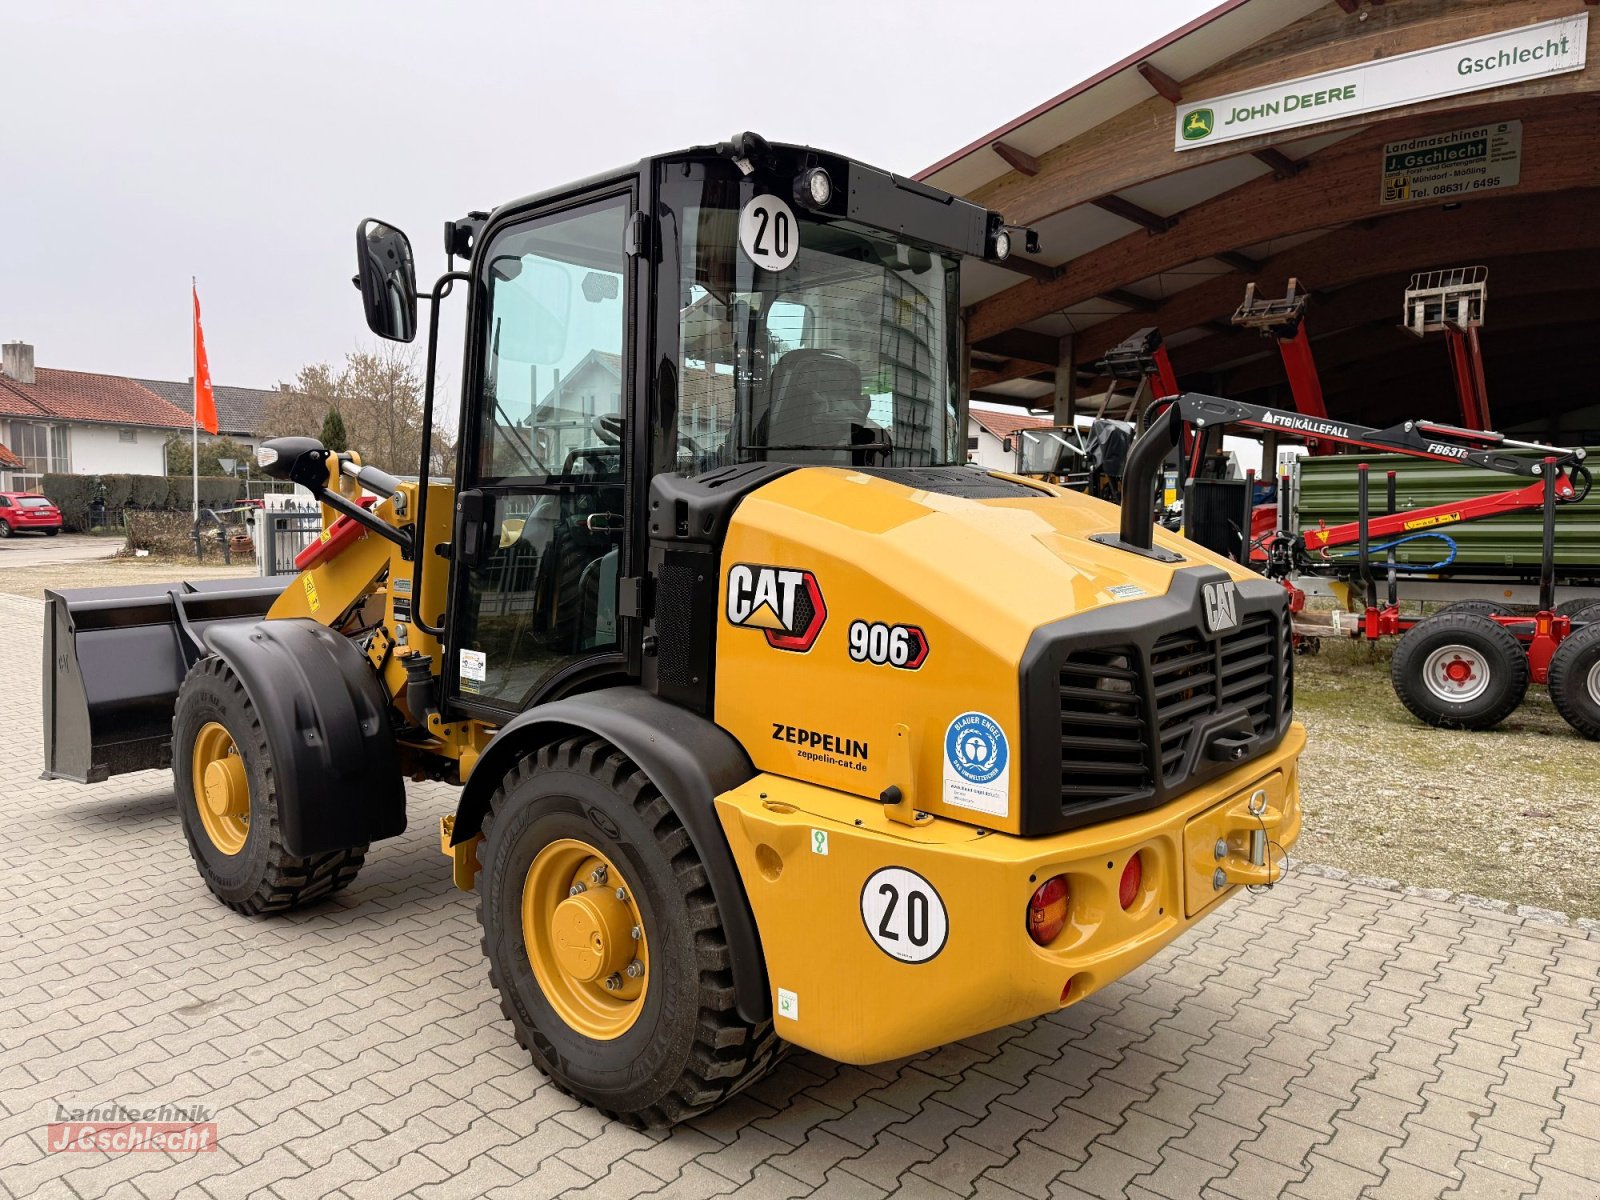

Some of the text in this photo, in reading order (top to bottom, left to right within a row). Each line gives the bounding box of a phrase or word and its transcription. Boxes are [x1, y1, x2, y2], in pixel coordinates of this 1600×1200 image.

[1457, 36, 1569, 75] Gschlecht
[1224, 84, 1357, 125] JOHN DEERE
[1386, 128, 1488, 154] Landmaschinen
[1388, 157, 1401, 170] J.
[1404, 142, 1484, 167] Gschlecht
[1411, 188, 1430, 199] Tel.
[1433, 183, 1463, 195] 08631
[1472, 177, 1501, 189] 6495
[1412, 172, 1448, 184] Mühldorf
[753, 207, 789, 259] 20
[729, 564, 803, 631] CAT
[1204, 581, 1237, 631] CAT
[850, 621, 909, 666] 906
[772, 723, 868, 760] ZEPPELIN
[954, 716, 1002, 741] BLAUER ENGEL
[797, 750, 868, 772] zeppelin-cat.de
[879, 883, 929, 947] 20
